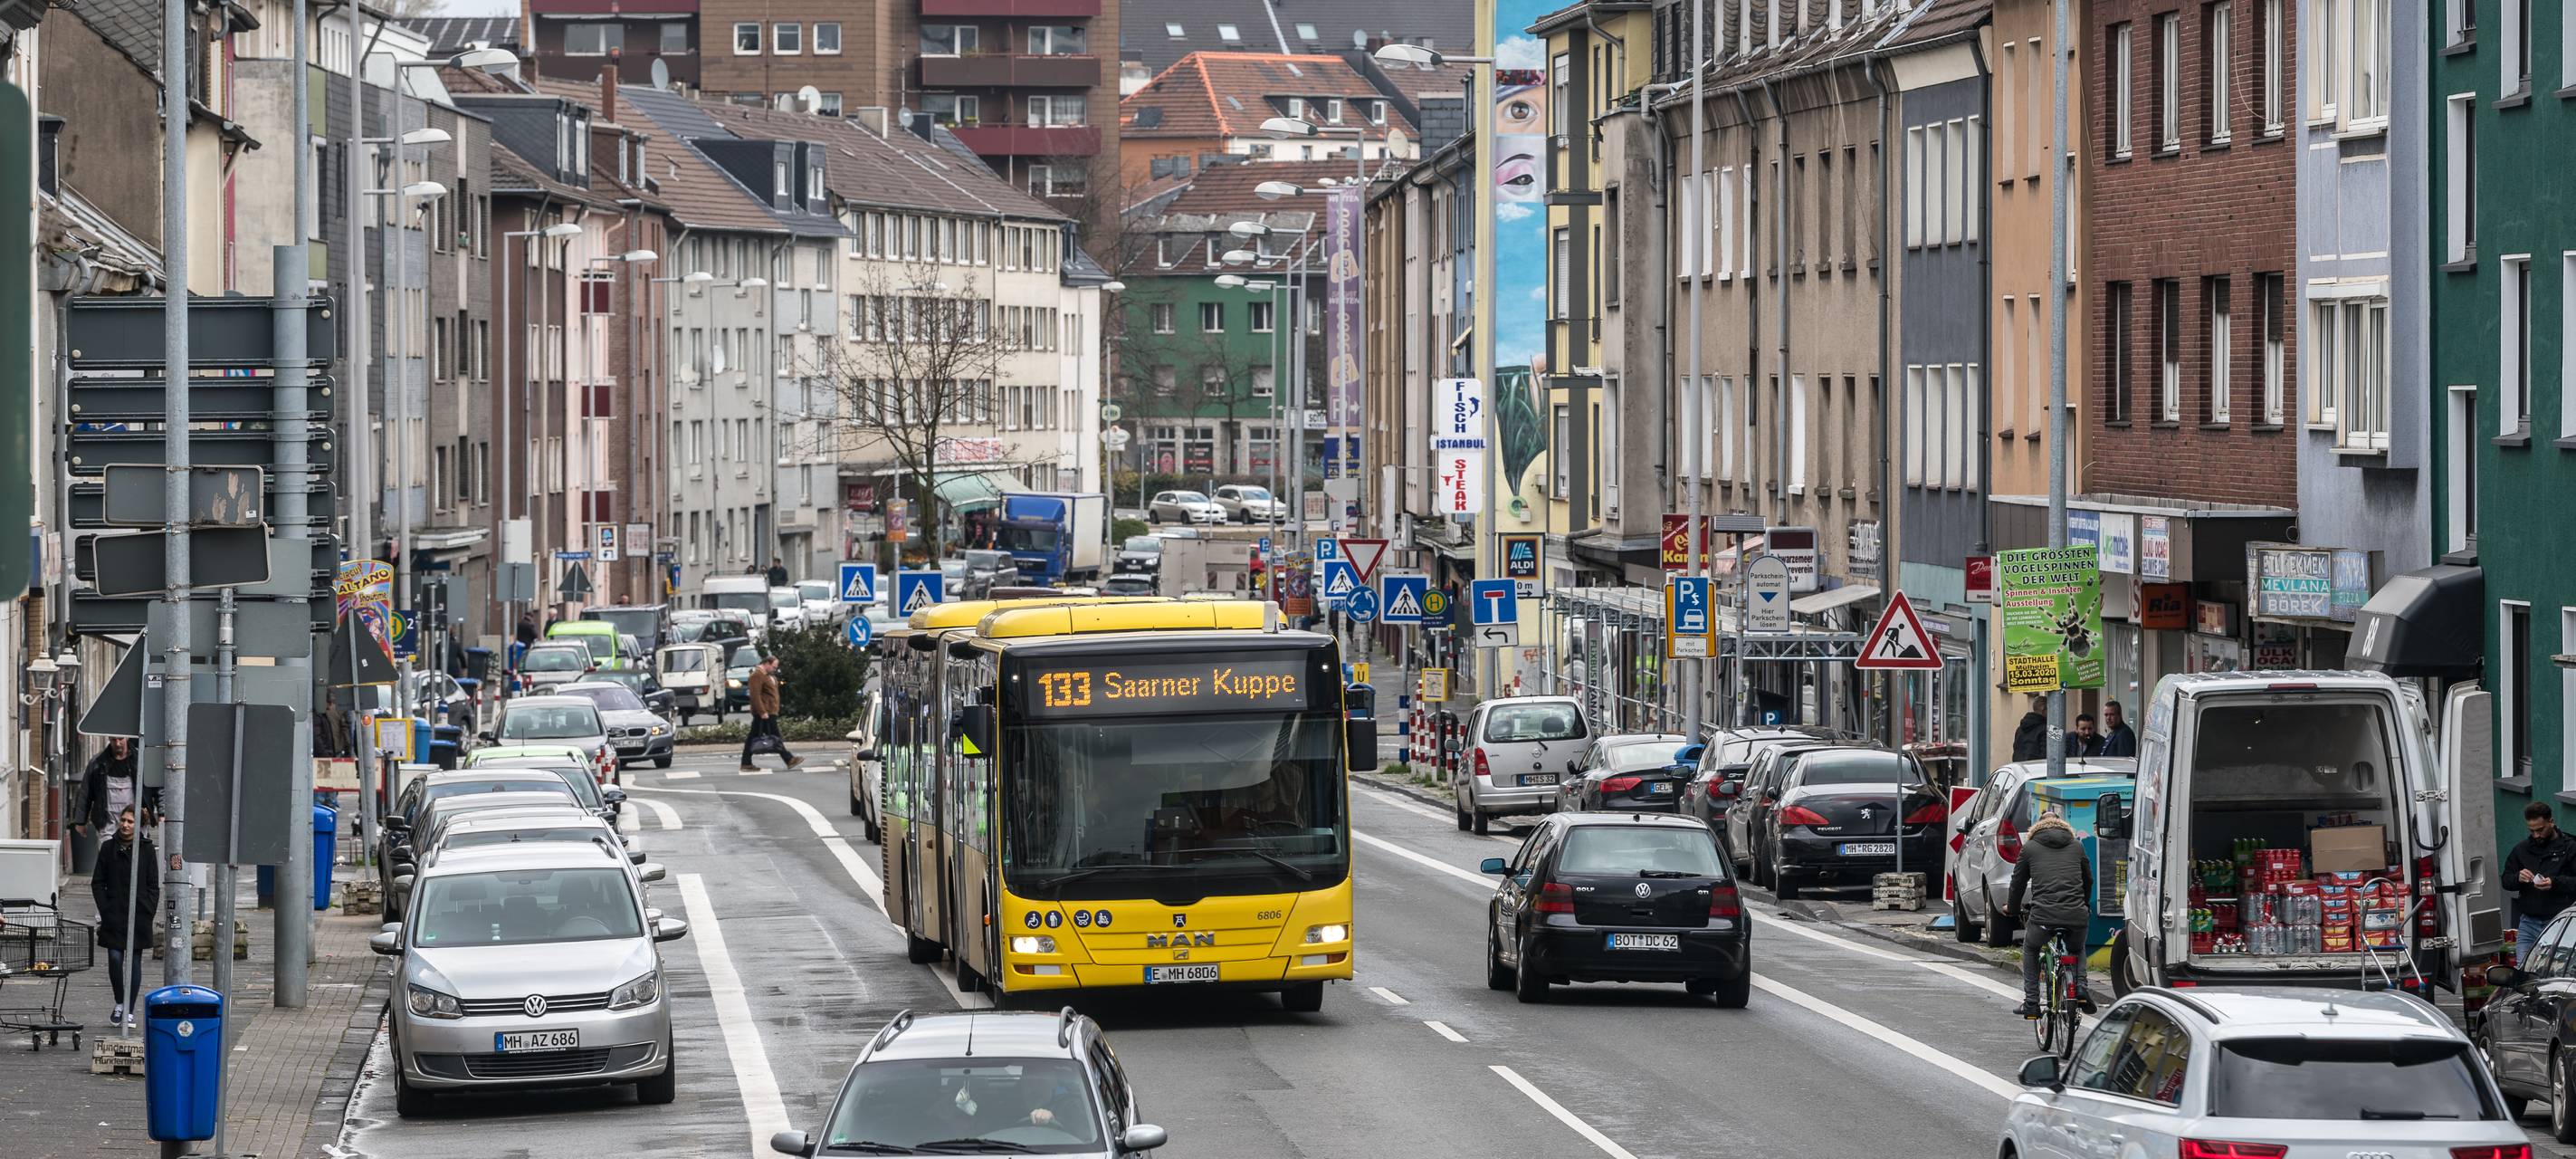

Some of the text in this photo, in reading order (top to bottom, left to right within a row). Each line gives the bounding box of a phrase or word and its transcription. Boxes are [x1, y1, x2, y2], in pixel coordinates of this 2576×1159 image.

[1455, 381, 1467, 434] FISCH
[1436, 439, 1486, 449] ISTANBUL
[1455, 459, 1467, 512] STEAK
[1321, 541, 1332, 558] P
[2007, 549, 2091, 562] DIE GRÖSSTEN
[1510, 561, 1534, 570] ALDI
[2004, 560, 2094, 574] VOGELSPINNEN
[338, 569, 389, 593] ALTANO
[2023, 573, 2080, 585] DER WELT
[1680, 580, 1694, 603] P
[2005, 589, 2038, 599] Spinnen
[2048, 586, 2083, 595] Insekten
[2261, 579, 2331, 593] MEVLANA
[2006, 599, 2054, 608] Ausstellung
[2149, 593, 2180, 612] Ria
[406, 618, 415, 629] 2
[2362, 617, 2380, 656] 88
[2008, 656, 2055, 665] STADTHALLE
[1358, 671, 1365, 683] U
[2009, 668, 2056, 678] 15.03.2020
[2010, 676, 2056, 685] Sonntag
[1038, 668, 1296, 707] 133 Saarner Kuppe
[1766, 712, 1776, 725] P
[1524, 775, 1556, 785] MH S 32
[1655, 782, 1669, 792] GEL
[1846, 844, 1894, 854] MH RG 2828
[1257, 910, 1283, 921] 6806
[1147, 932, 1216, 948] MAN
[1615, 934, 1677, 947] BOT DC 62
[1152, 966, 1217, 981] E MH 6806
[504, 1036, 522, 1049] MH
[531, 1034, 549, 1048] AZ
[551, 1032, 577, 1046] 686
[96, 1042, 145, 1054] Hundertma
